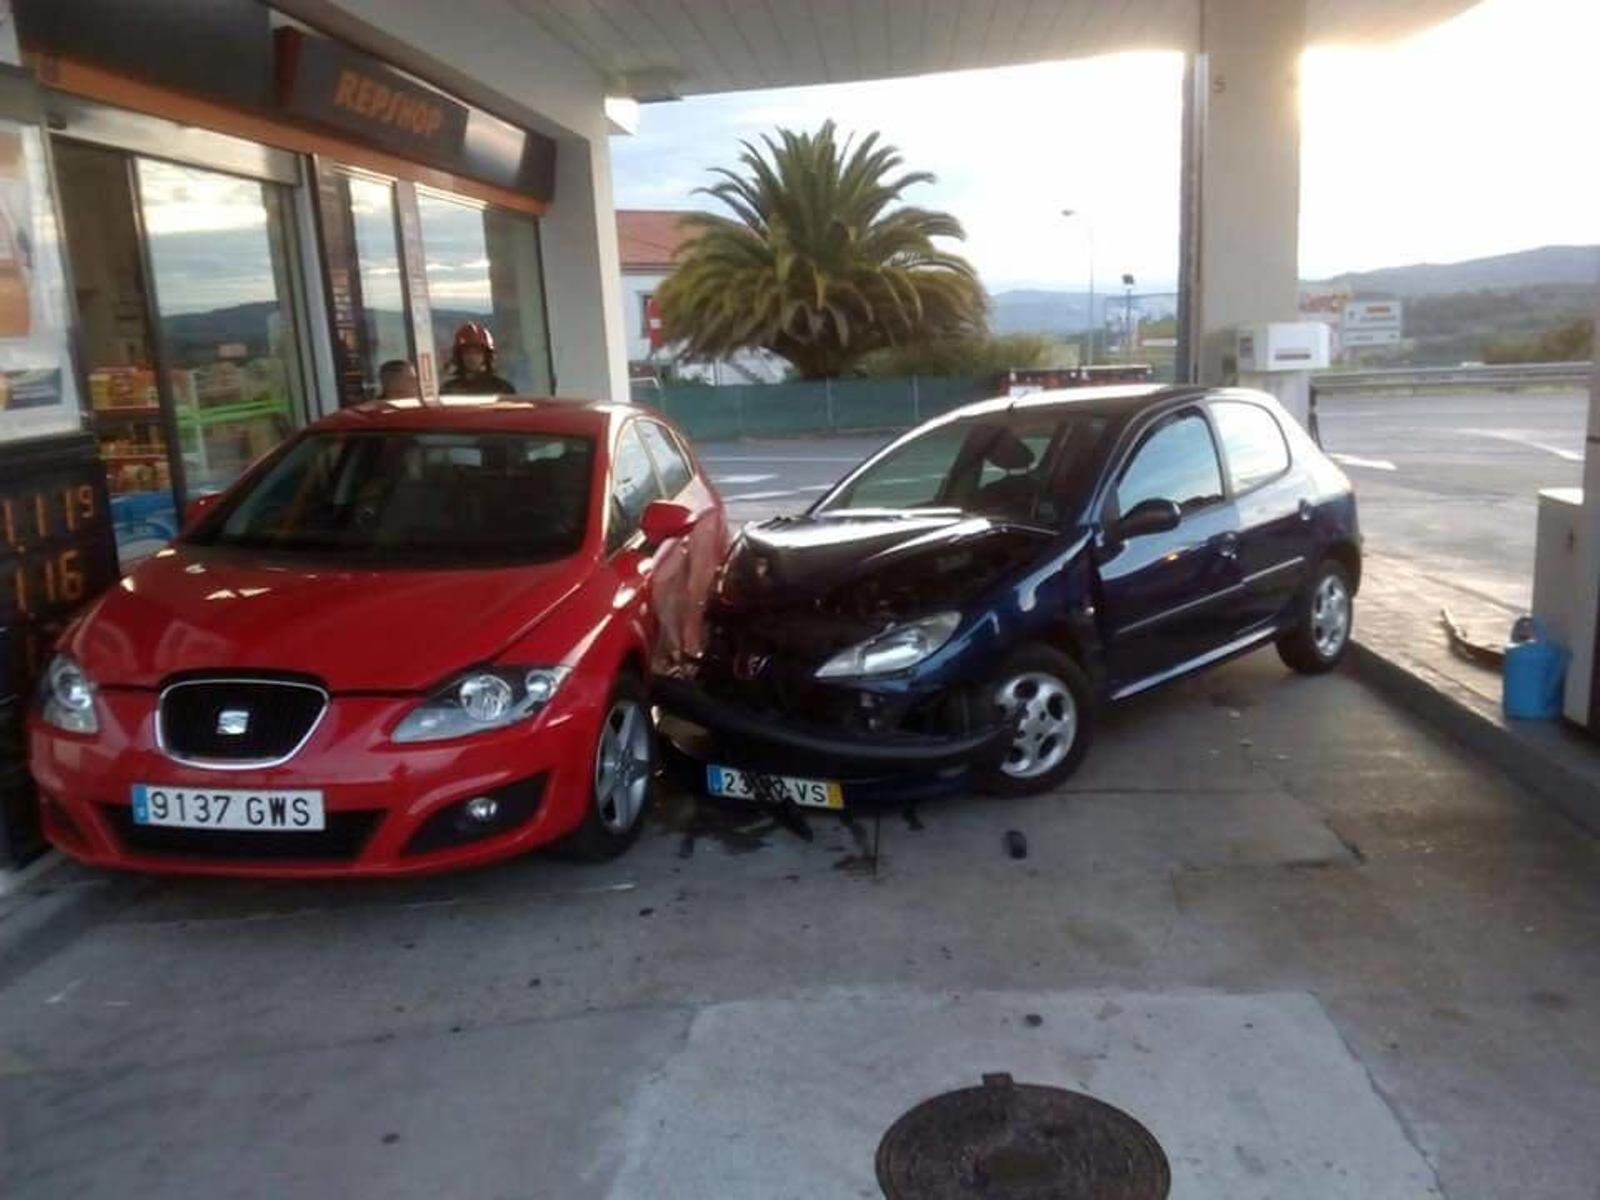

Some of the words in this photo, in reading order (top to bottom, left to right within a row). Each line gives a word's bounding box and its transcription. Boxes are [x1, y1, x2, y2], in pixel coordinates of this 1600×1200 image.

[336, 71, 442, 135] REPSHOP
[150, 790, 231, 824] 9137
[245, 796, 311, 827] GWS
